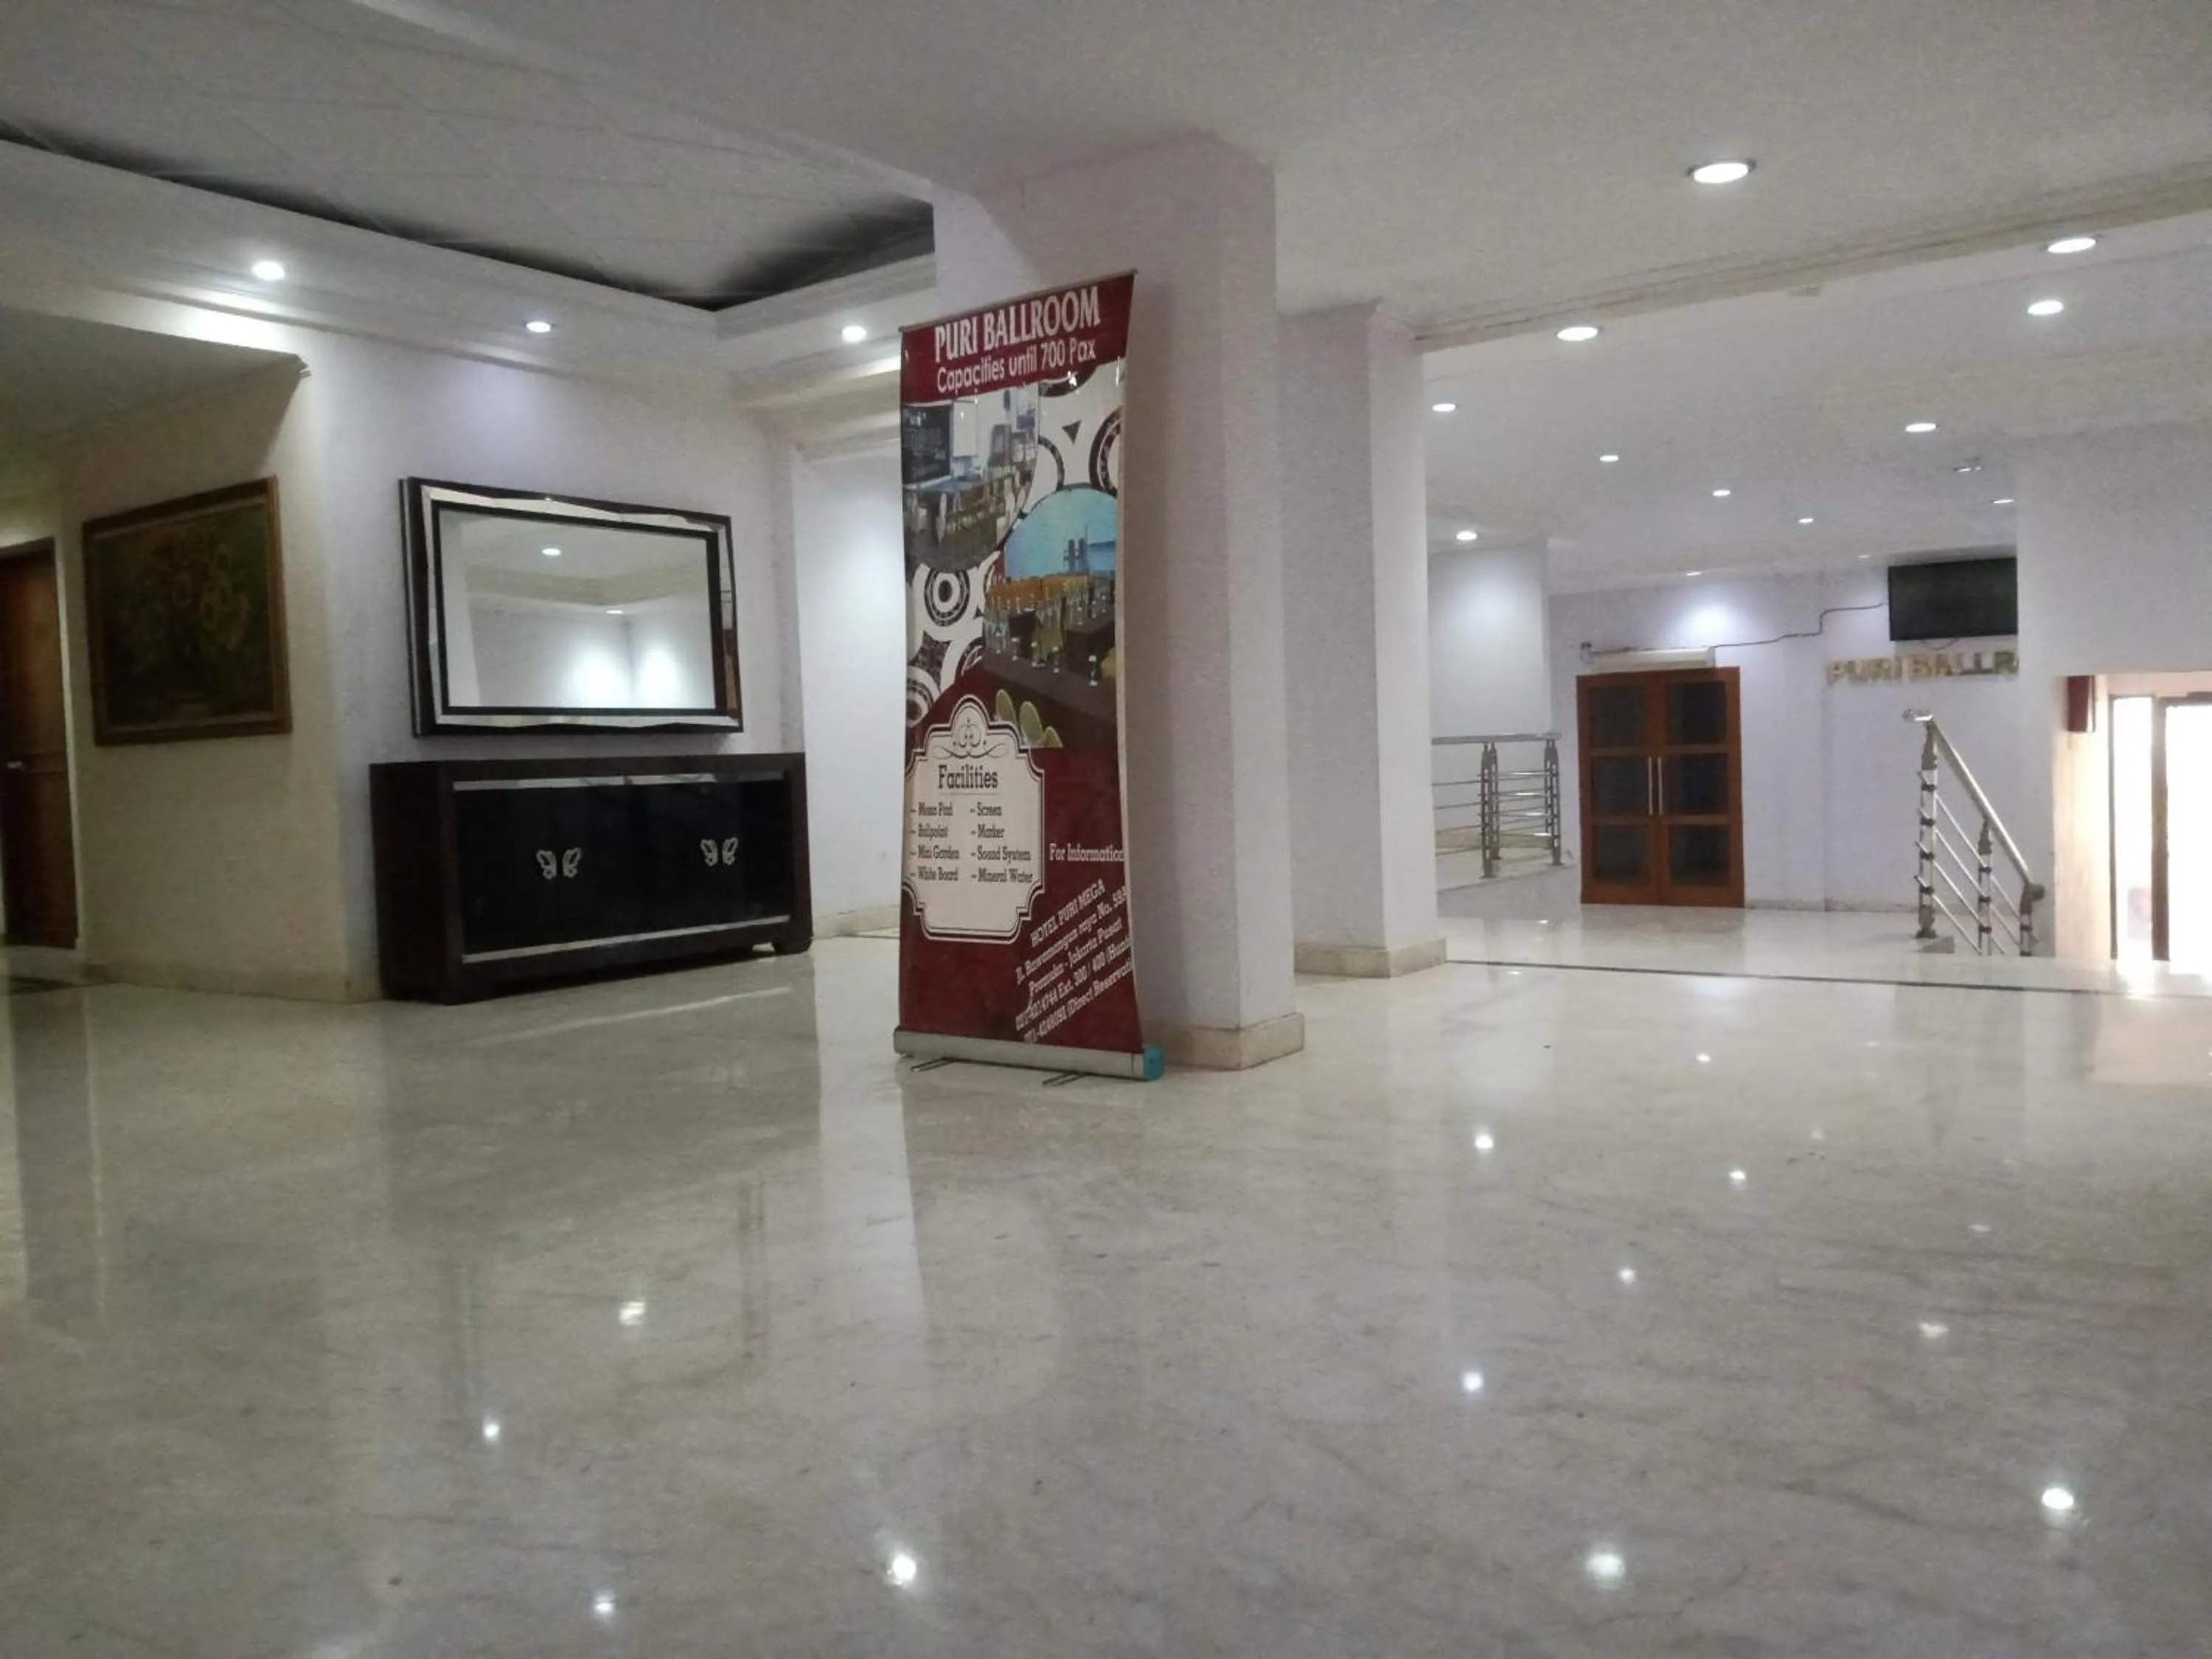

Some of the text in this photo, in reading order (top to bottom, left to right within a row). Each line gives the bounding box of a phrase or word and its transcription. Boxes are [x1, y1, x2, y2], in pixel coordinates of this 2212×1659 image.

[933, 285, 1101, 364] PURI BALLROOM
[936, 336, 1098, 396] Capacities until 700 Pax
[1828, 650, 2019, 685] PURI BALLR
[937, 762, 998, 790] Facilities
[977, 801, 1003, 817] Screen
[977, 823, 1005, 838] Marker
[977, 844, 1032, 864] Sound System
[1049, 843, 1065, 861] For
[938, 866, 959, 881] Board
[978, 867, 1034, 883] Mineral Water
[1030, 879, 1105, 947] HOTEL PURI MEGA
